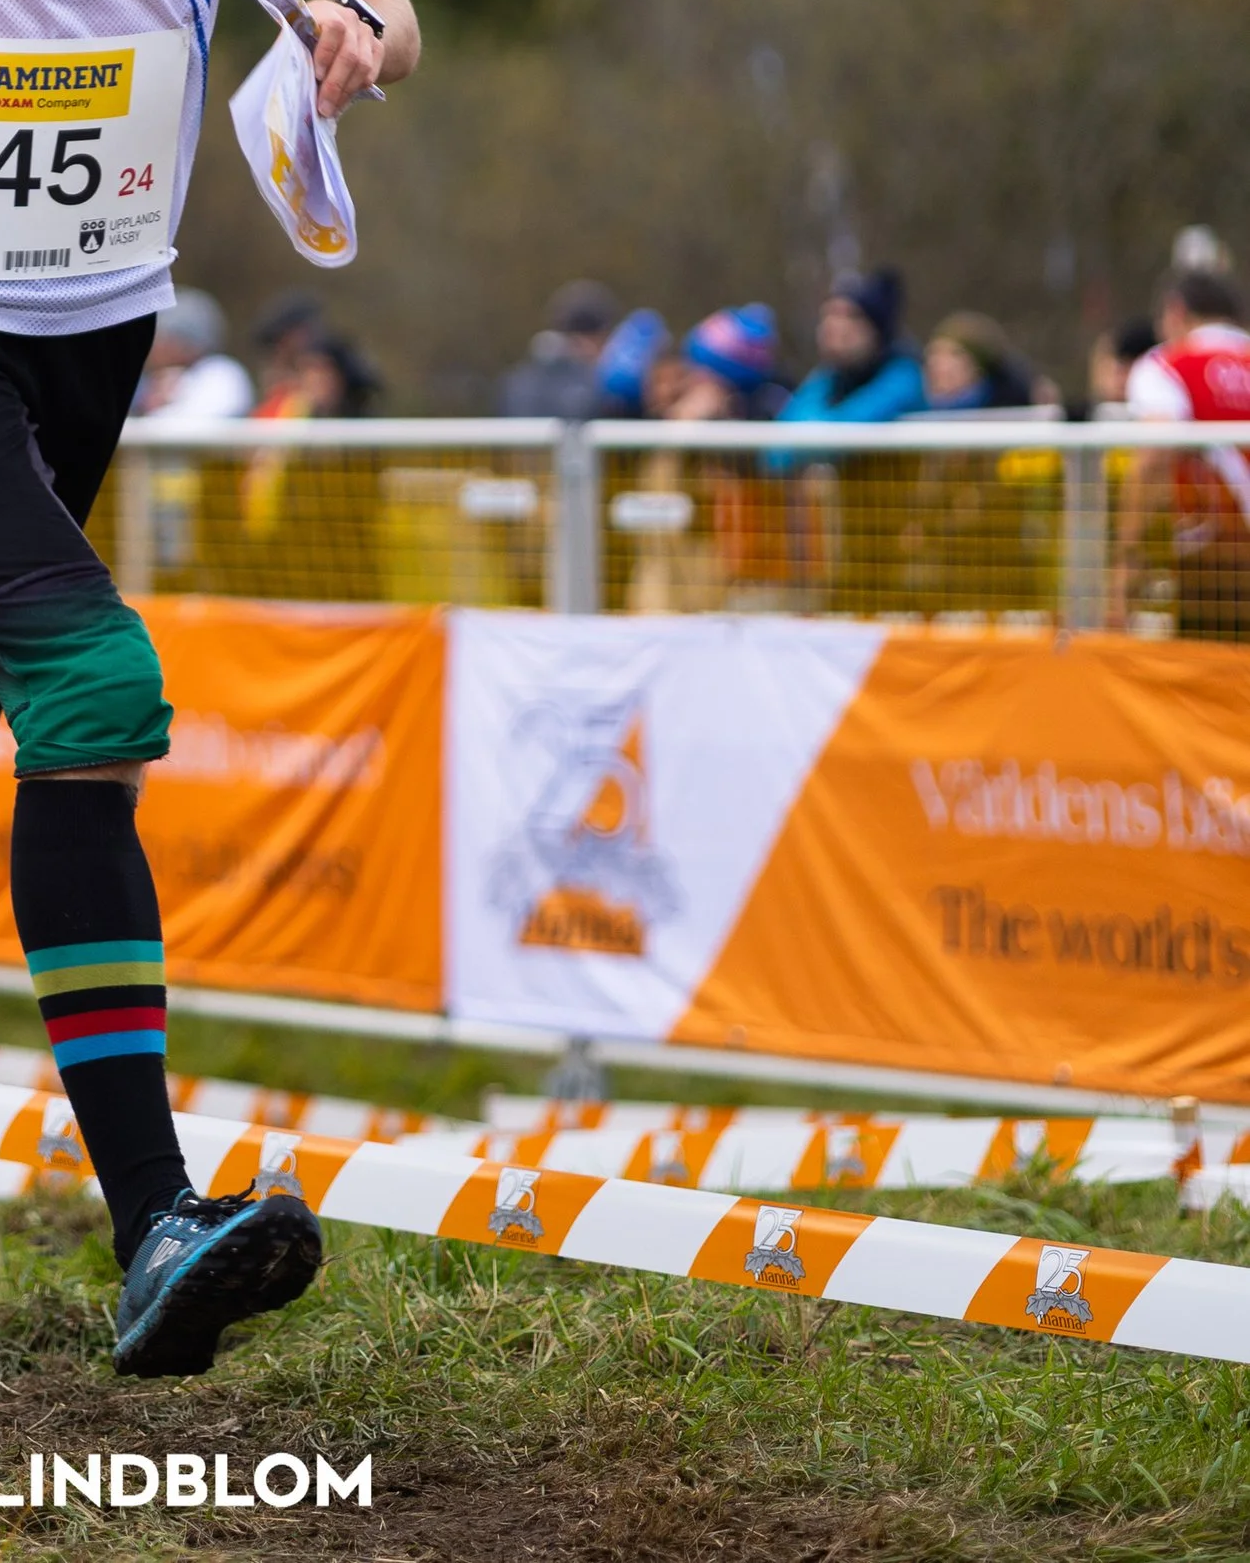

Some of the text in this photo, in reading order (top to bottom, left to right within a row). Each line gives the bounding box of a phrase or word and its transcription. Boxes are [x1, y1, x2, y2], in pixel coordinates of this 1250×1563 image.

[37, 96, 92, 110] Company
[118, 164, 154, 197] 24
[110, 210, 161, 231] UPPLANDS
[759, 1209, 796, 1254] 25
[1041, 1249, 1082, 1297] 25
